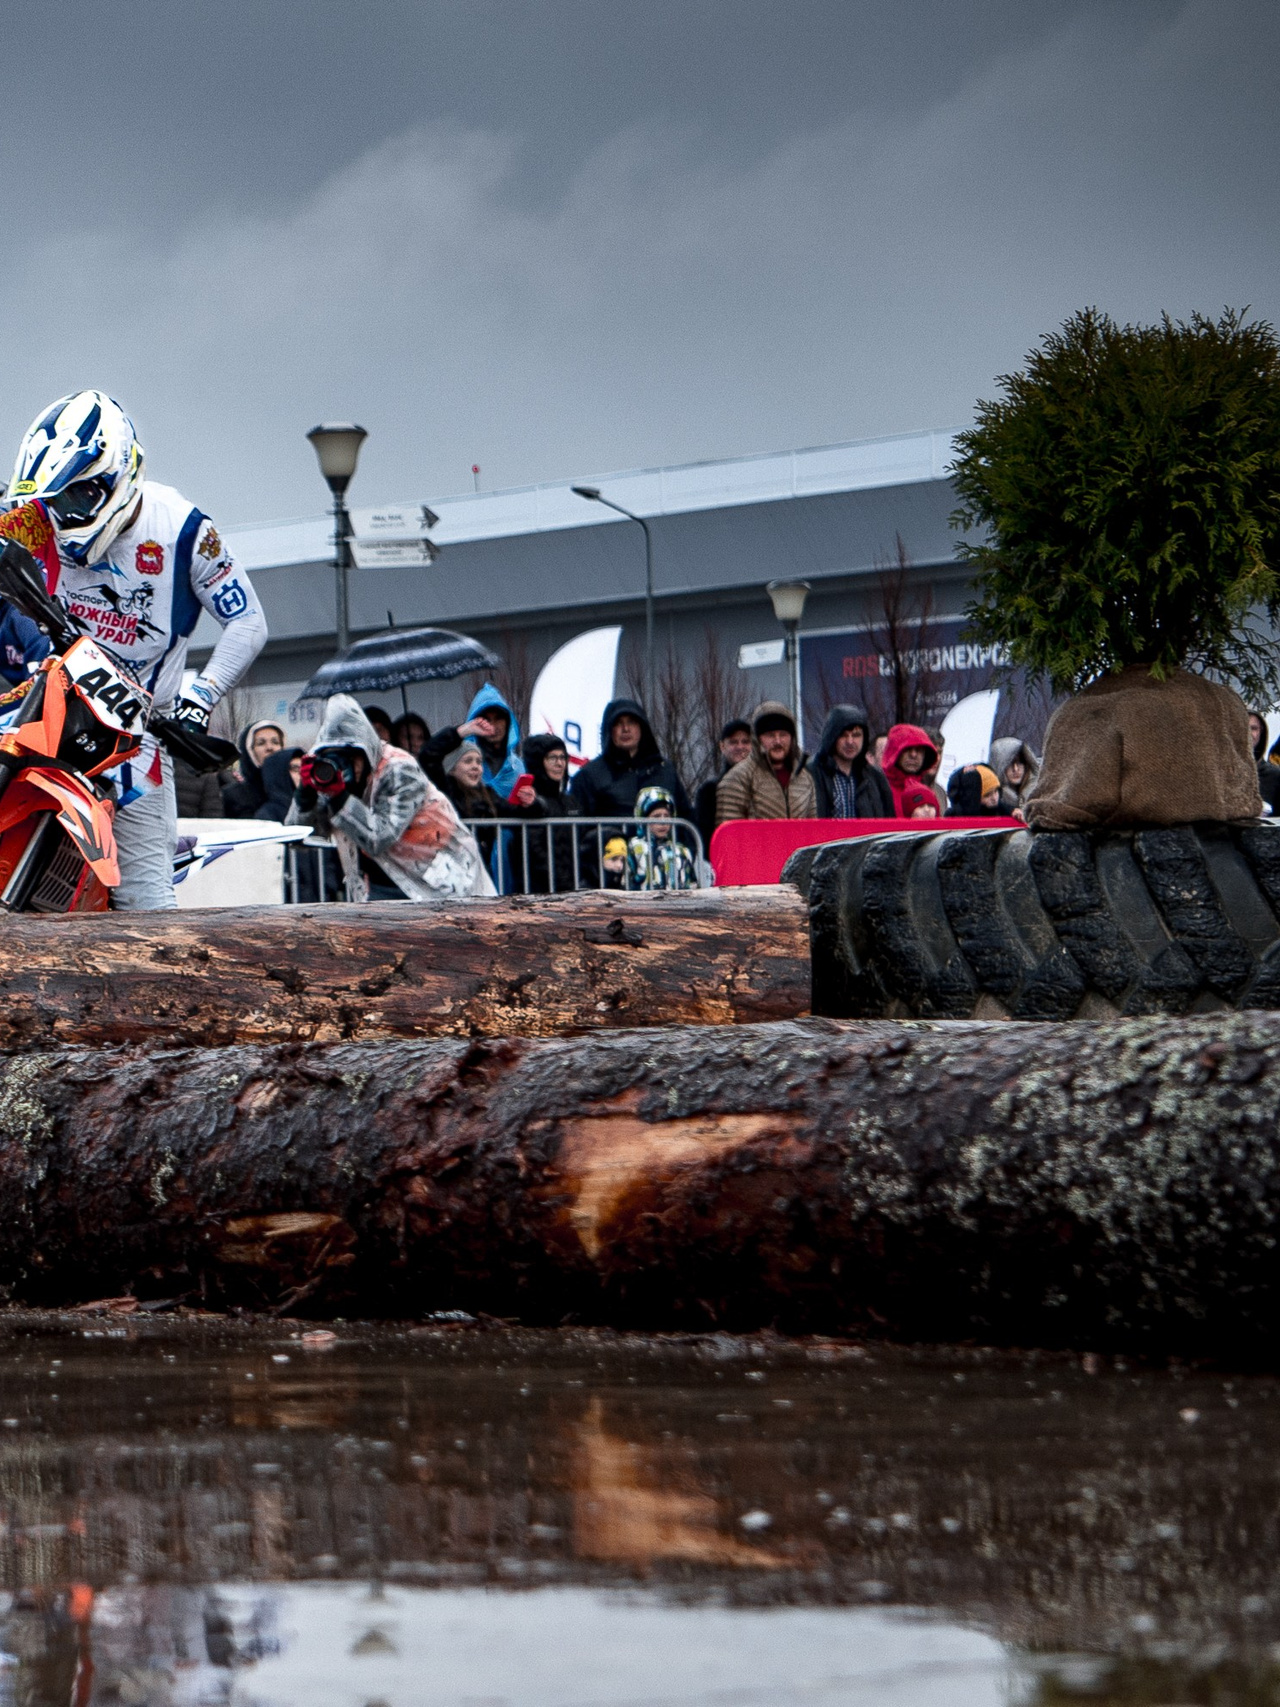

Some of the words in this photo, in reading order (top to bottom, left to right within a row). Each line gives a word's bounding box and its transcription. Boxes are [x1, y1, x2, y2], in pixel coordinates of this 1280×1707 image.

[70, 603, 138, 630] ЮЖНЫЙ
[94, 625, 137, 646] УРАЛ
[75, 668, 142, 728] 444
